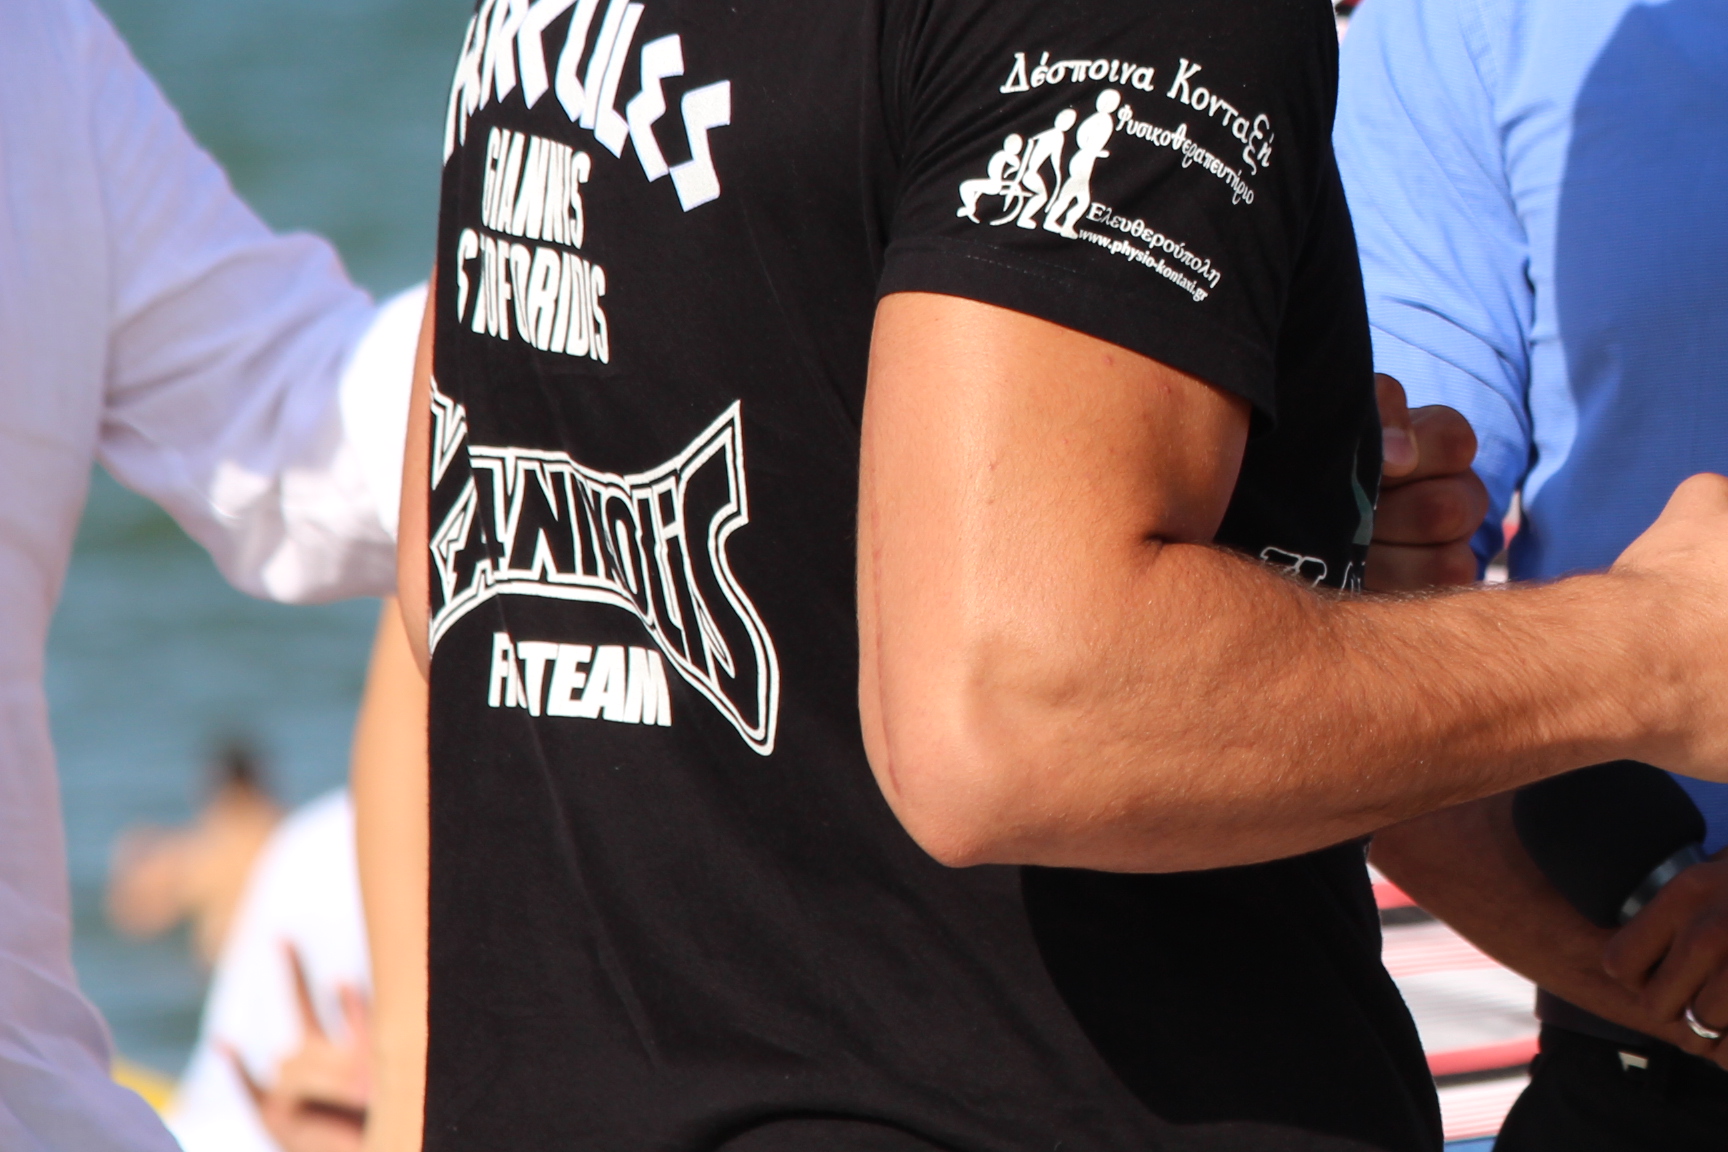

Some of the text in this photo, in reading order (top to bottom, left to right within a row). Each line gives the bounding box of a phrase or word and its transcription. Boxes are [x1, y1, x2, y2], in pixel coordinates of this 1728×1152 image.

[1000, 51, 1155, 94] Δέσποινα
[482, 126, 592, 250] GIANNIS
[1078, 229, 1208, 302] www.physio-kontaxi.gr
[1086, 202, 1222, 289] Ελευθερούπολη
